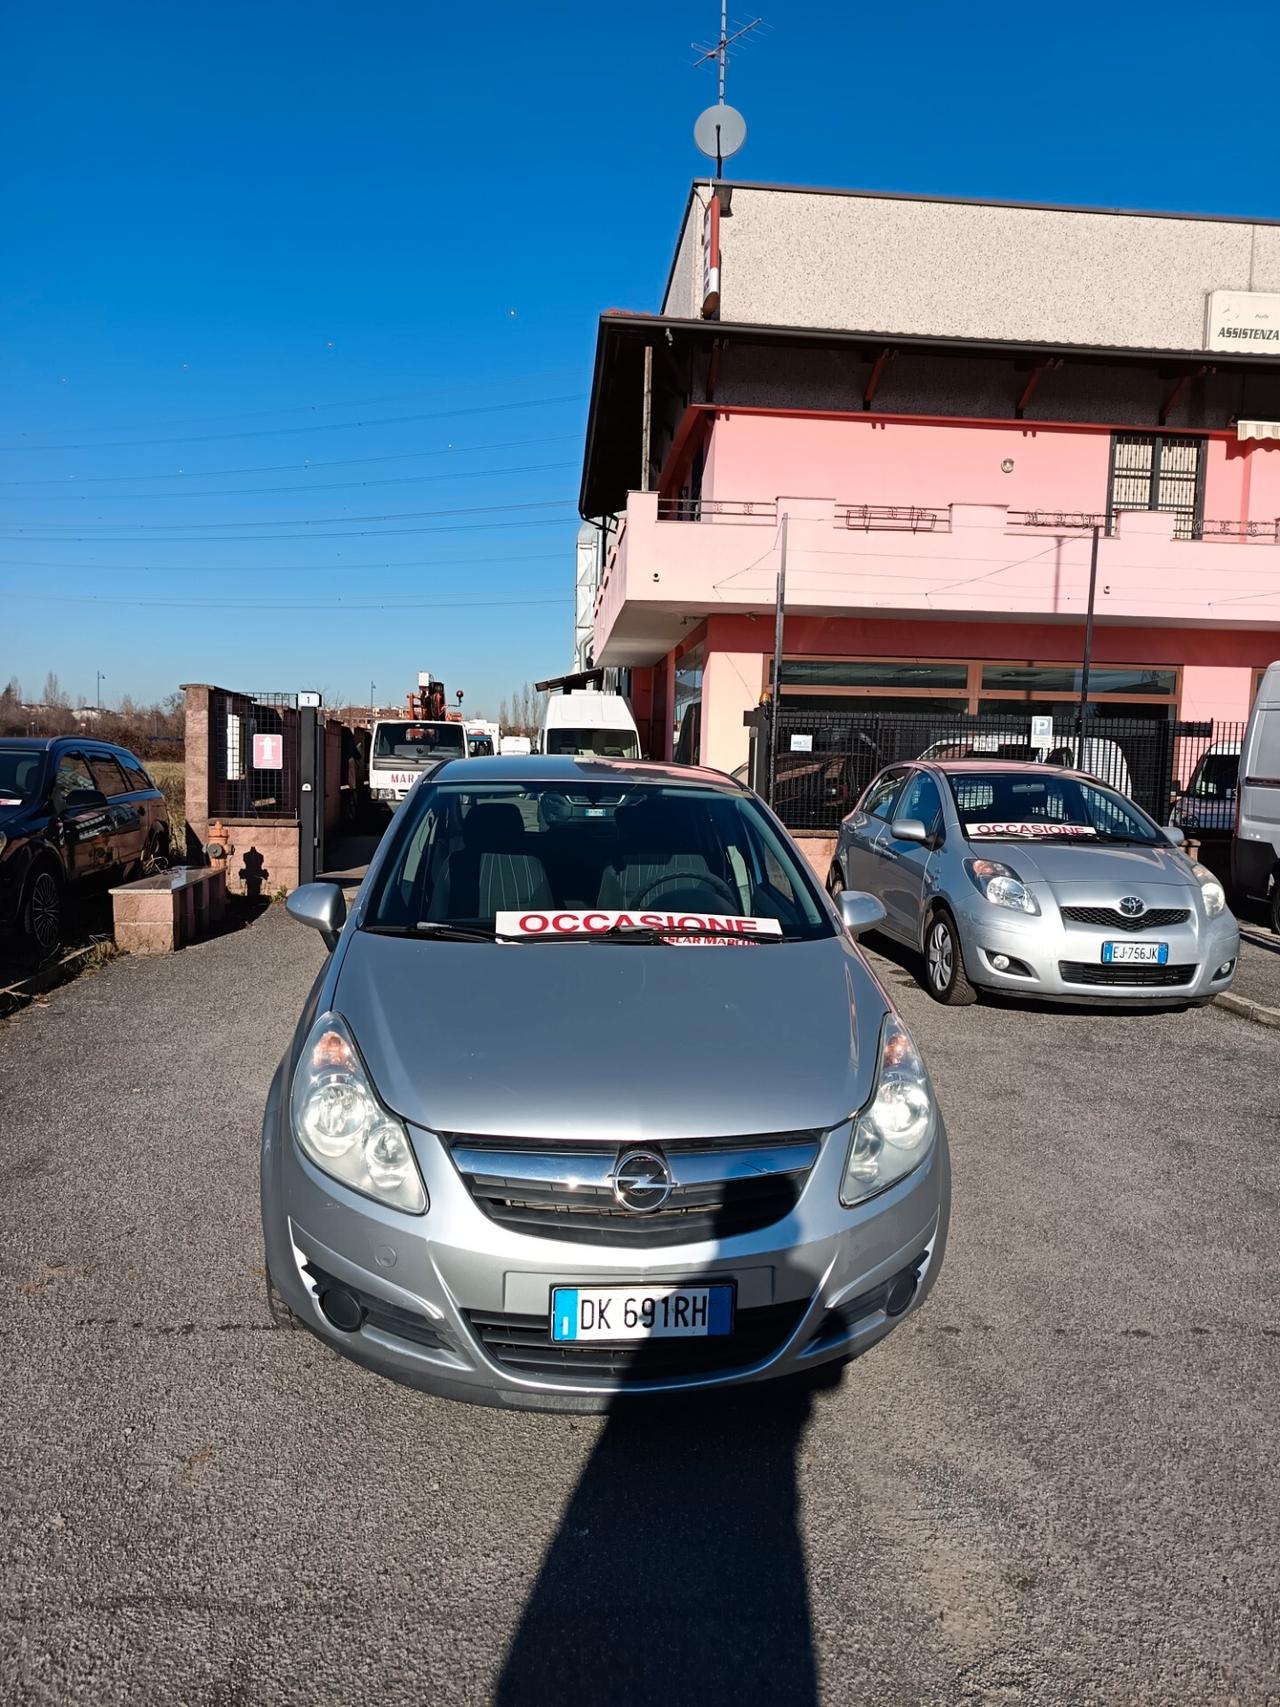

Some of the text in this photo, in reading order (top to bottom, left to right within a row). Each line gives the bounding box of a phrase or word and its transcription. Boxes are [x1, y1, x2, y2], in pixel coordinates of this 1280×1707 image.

[1217, 327, 1280, 341] ASSISTENZA
[1035, 719, 1049, 735] P
[977, 824, 1085, 835] OCCASIONE
[519, 914, 758, 933] OCCASIONE
[580, 1295, 708, 1330] DK 691RH
